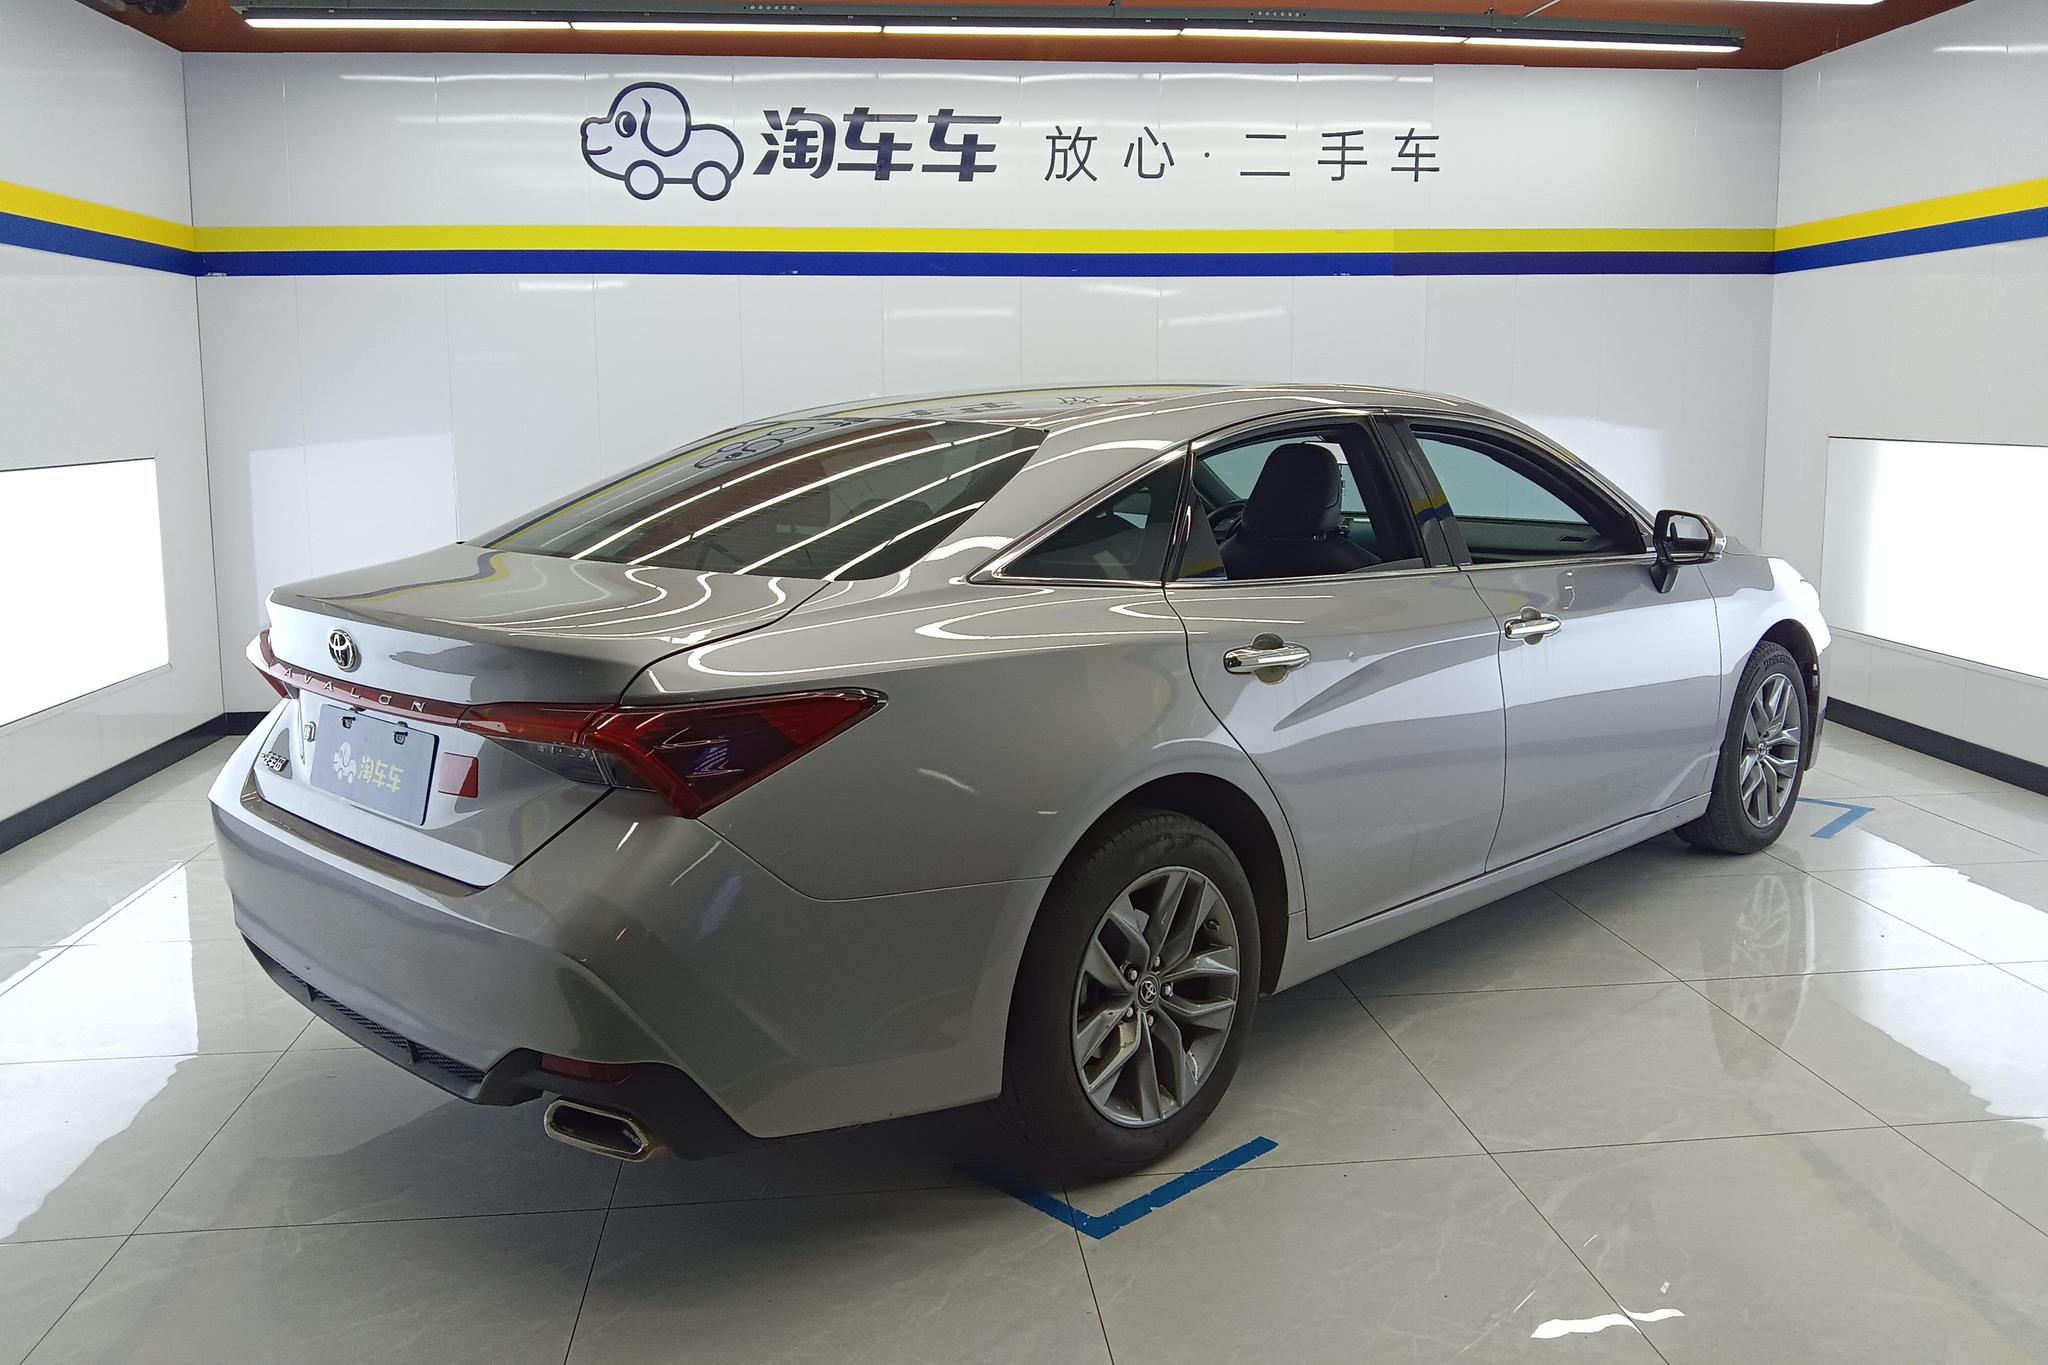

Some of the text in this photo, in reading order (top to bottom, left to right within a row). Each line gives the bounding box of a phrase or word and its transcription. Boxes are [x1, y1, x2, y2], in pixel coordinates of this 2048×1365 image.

[753, 107, 1002, 182] 淘车车
[283, 667, 426, 712] AVALON
[358, 756, 403, 792] 淘车车
